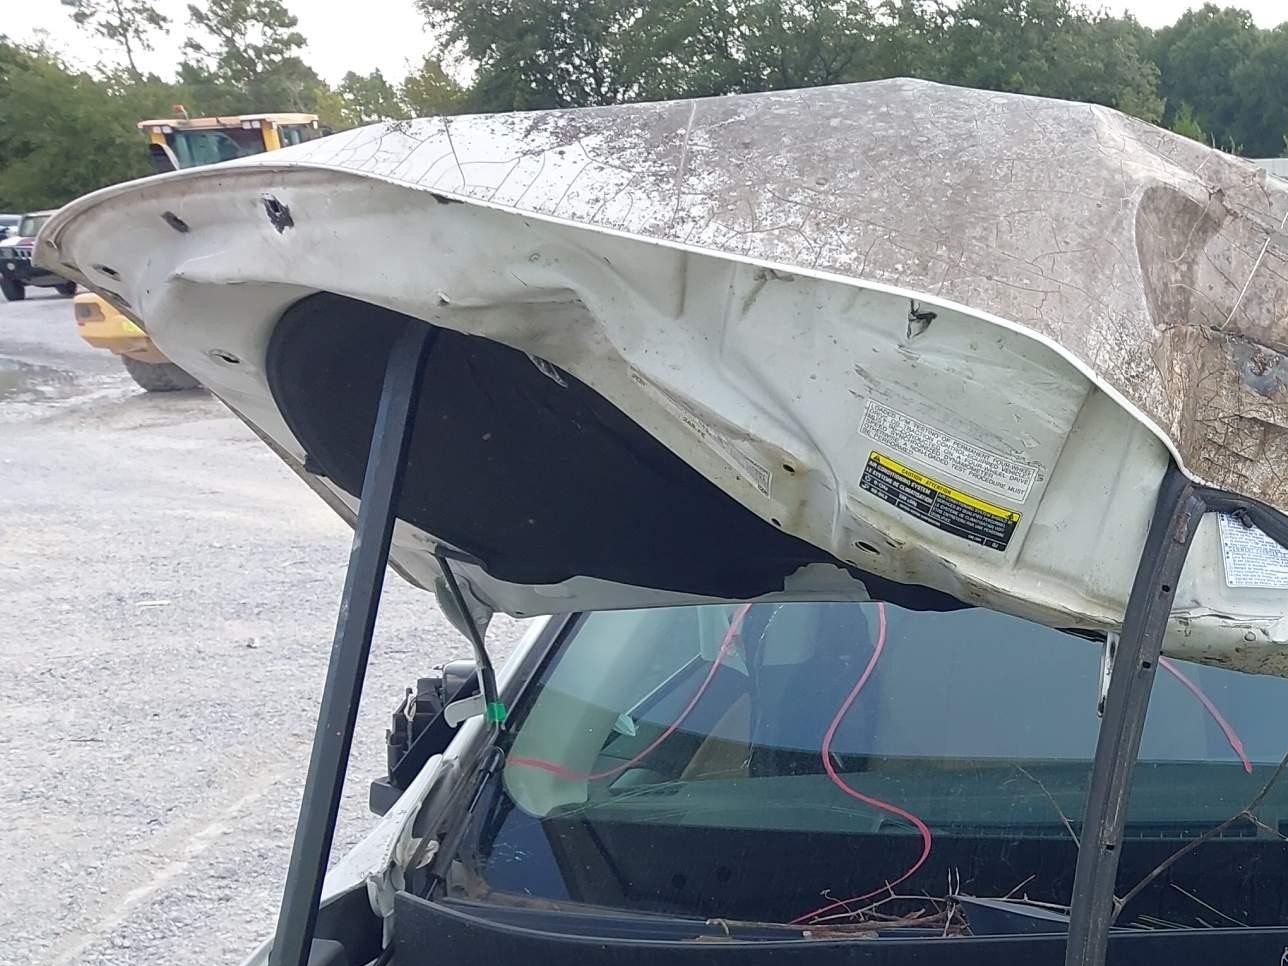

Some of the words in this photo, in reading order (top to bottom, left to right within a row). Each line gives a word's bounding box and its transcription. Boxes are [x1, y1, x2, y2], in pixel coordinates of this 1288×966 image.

[866, 418, 887, 431] SPEED
[890, 430, 941, 456] SYNCHRONIZED
[871, 404, 896, 418] LOADED
[913, 423, 939, 438] TESTING
[953, 441, 990, 460] PERMANENT
[902, 424, 934, 442] TRACTION
[900, 429, 941, 451] CONDUCTED
[1009, 475, 1028, 485] DRIVE
[910, 445, 949, 465] NON-LOADED
[951, 463, 966, 473] TEST
[968, 470, 1006, 488] PROCEDURE
[1007, 486, 1024, 495] MUST
[877, 465, 911, 484] CONDITIONING
[911, 482, 930, 494] SYSTEM
[901, 468, 922, 481] CAUTION
[926, 480, 951, 494] ATTENTION
